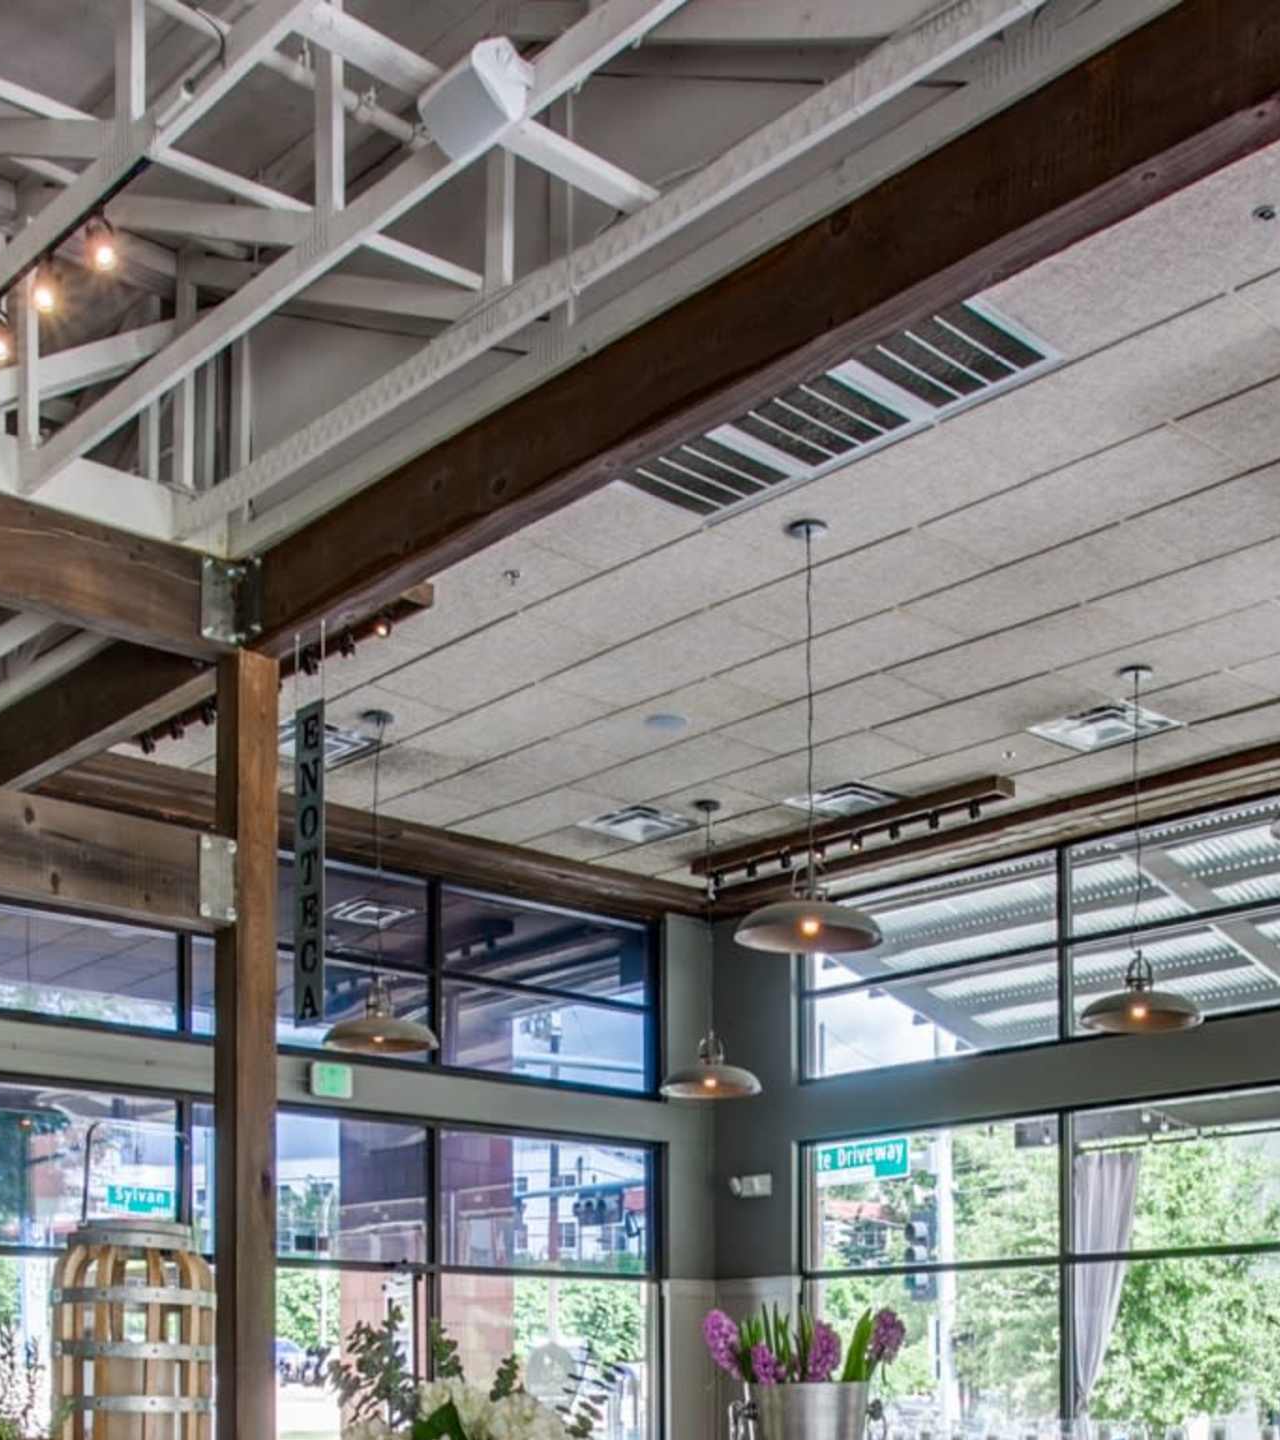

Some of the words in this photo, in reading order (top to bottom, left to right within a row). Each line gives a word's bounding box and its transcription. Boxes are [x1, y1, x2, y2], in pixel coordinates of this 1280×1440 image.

[299, 713, 320, 1020] ENOTECA
[837, 1142, 904, 1167] Driveway
[114, 1185, 165, 1207] Sylvan
